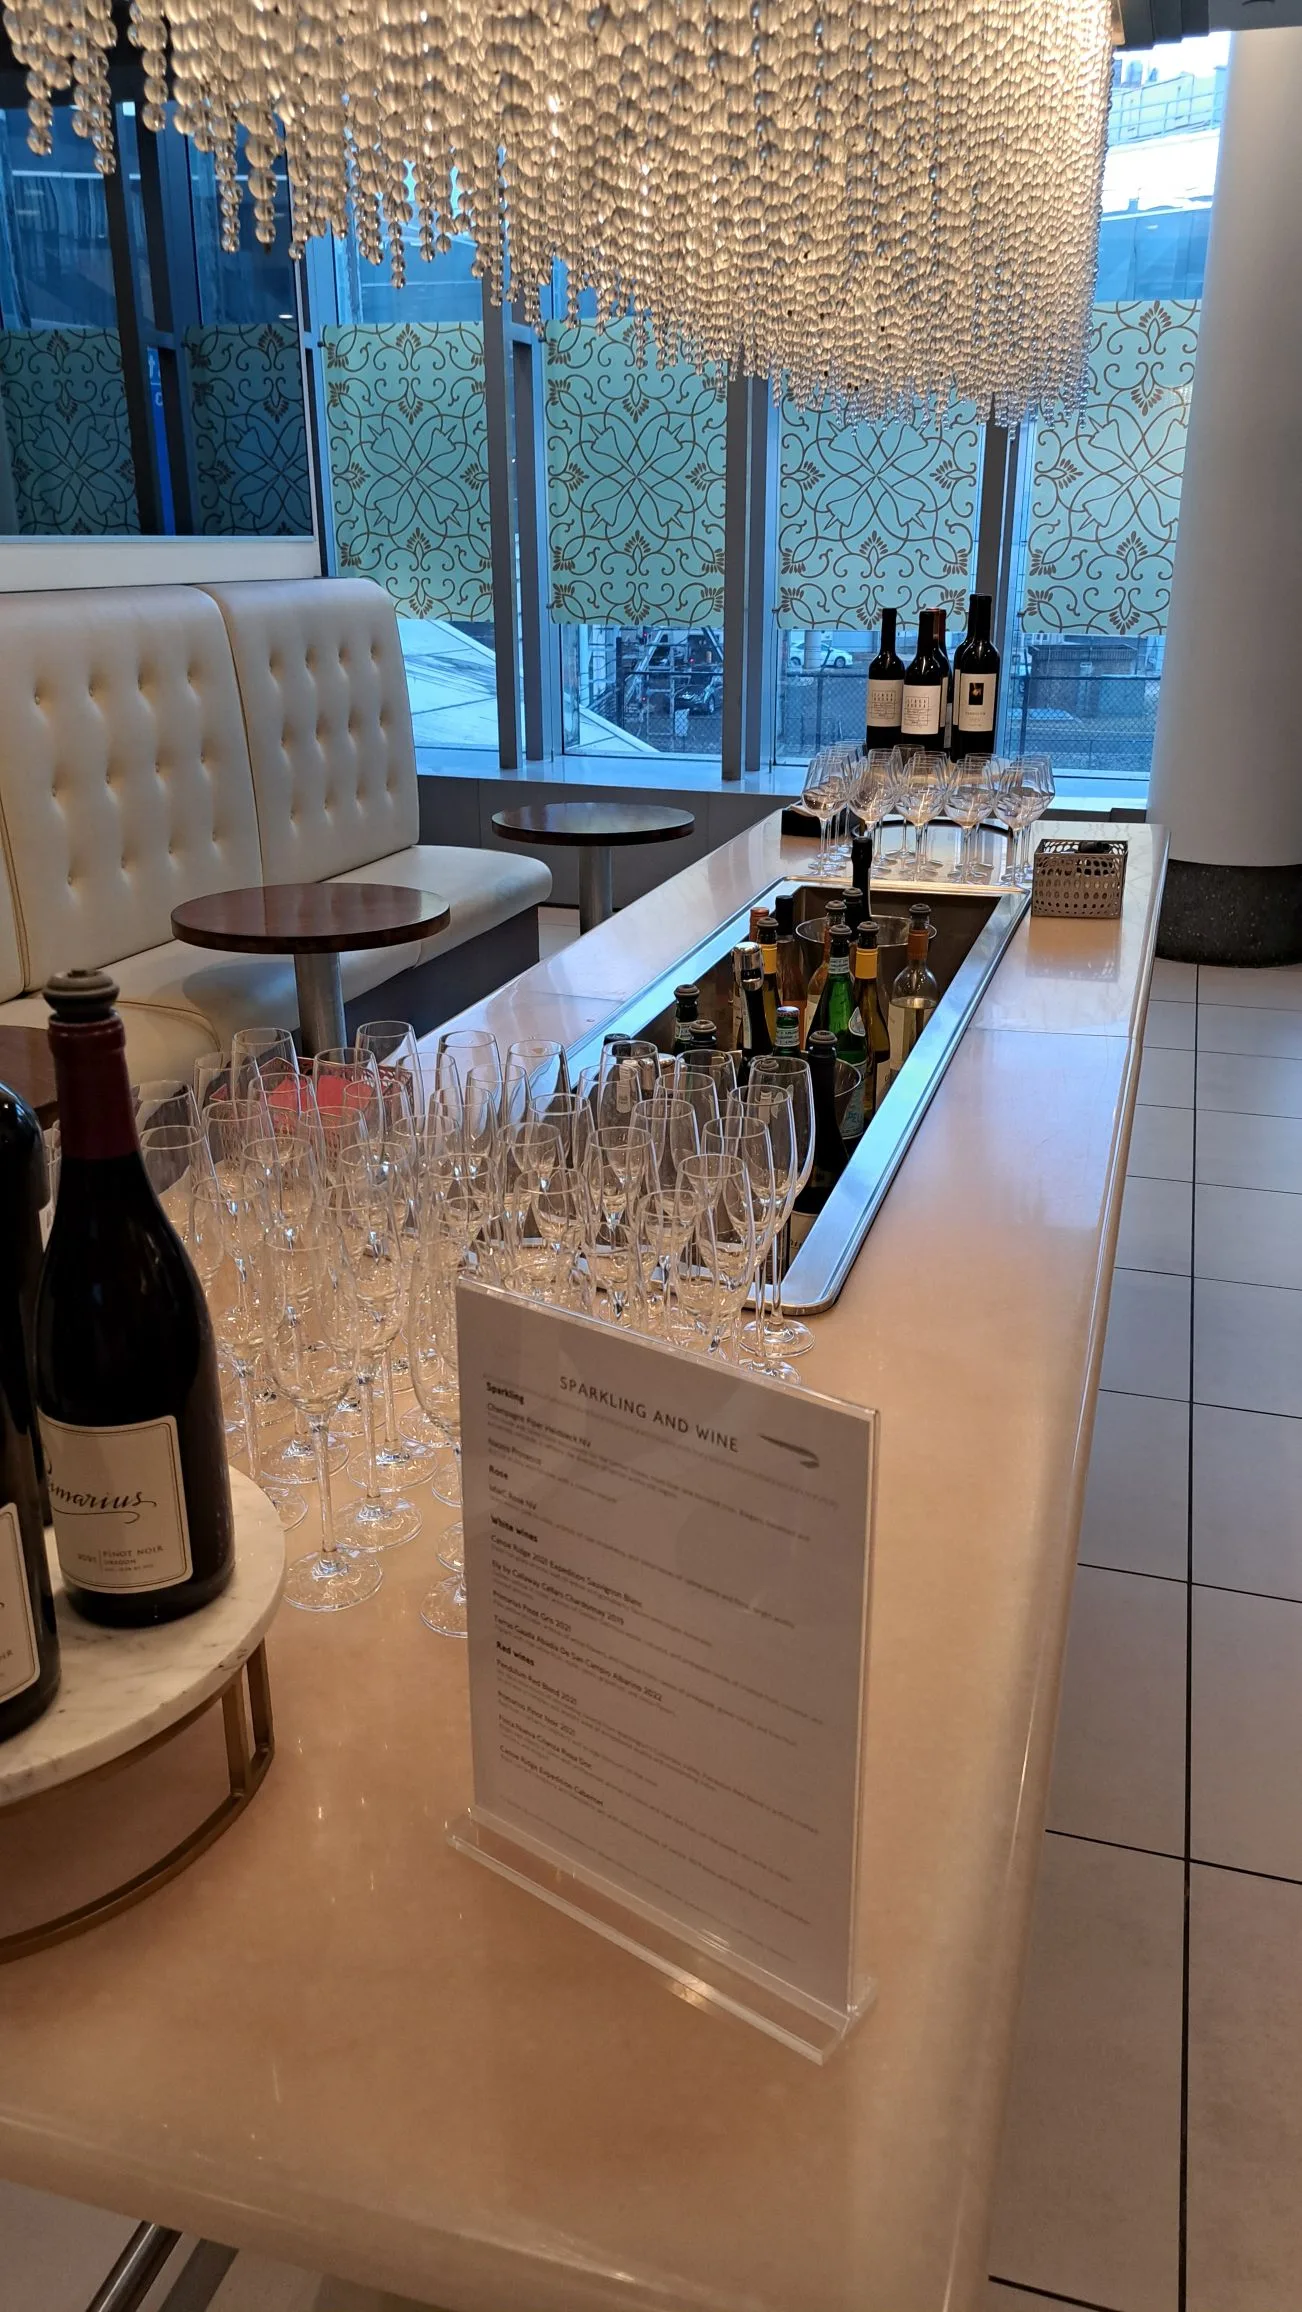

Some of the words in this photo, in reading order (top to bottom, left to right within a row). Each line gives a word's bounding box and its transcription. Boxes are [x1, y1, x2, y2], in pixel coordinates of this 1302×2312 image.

[486, 1381, 523, 1405] Sparkling
[559, 1374, 645, 1419] SPARKLING
[652, 1407, 688, 1435] AND
[695, 1423, 738, 1453] WINE
[490, 1514, 513, 1531] White
[515, 1525, 537, 1542] wines
[103, 1549, 132, 1558] PINOT
[137, 1545, 164, 1556] NOIR
[496, 1639, 511, 1654] Red
[512, 1647, 534, 1666] wines
